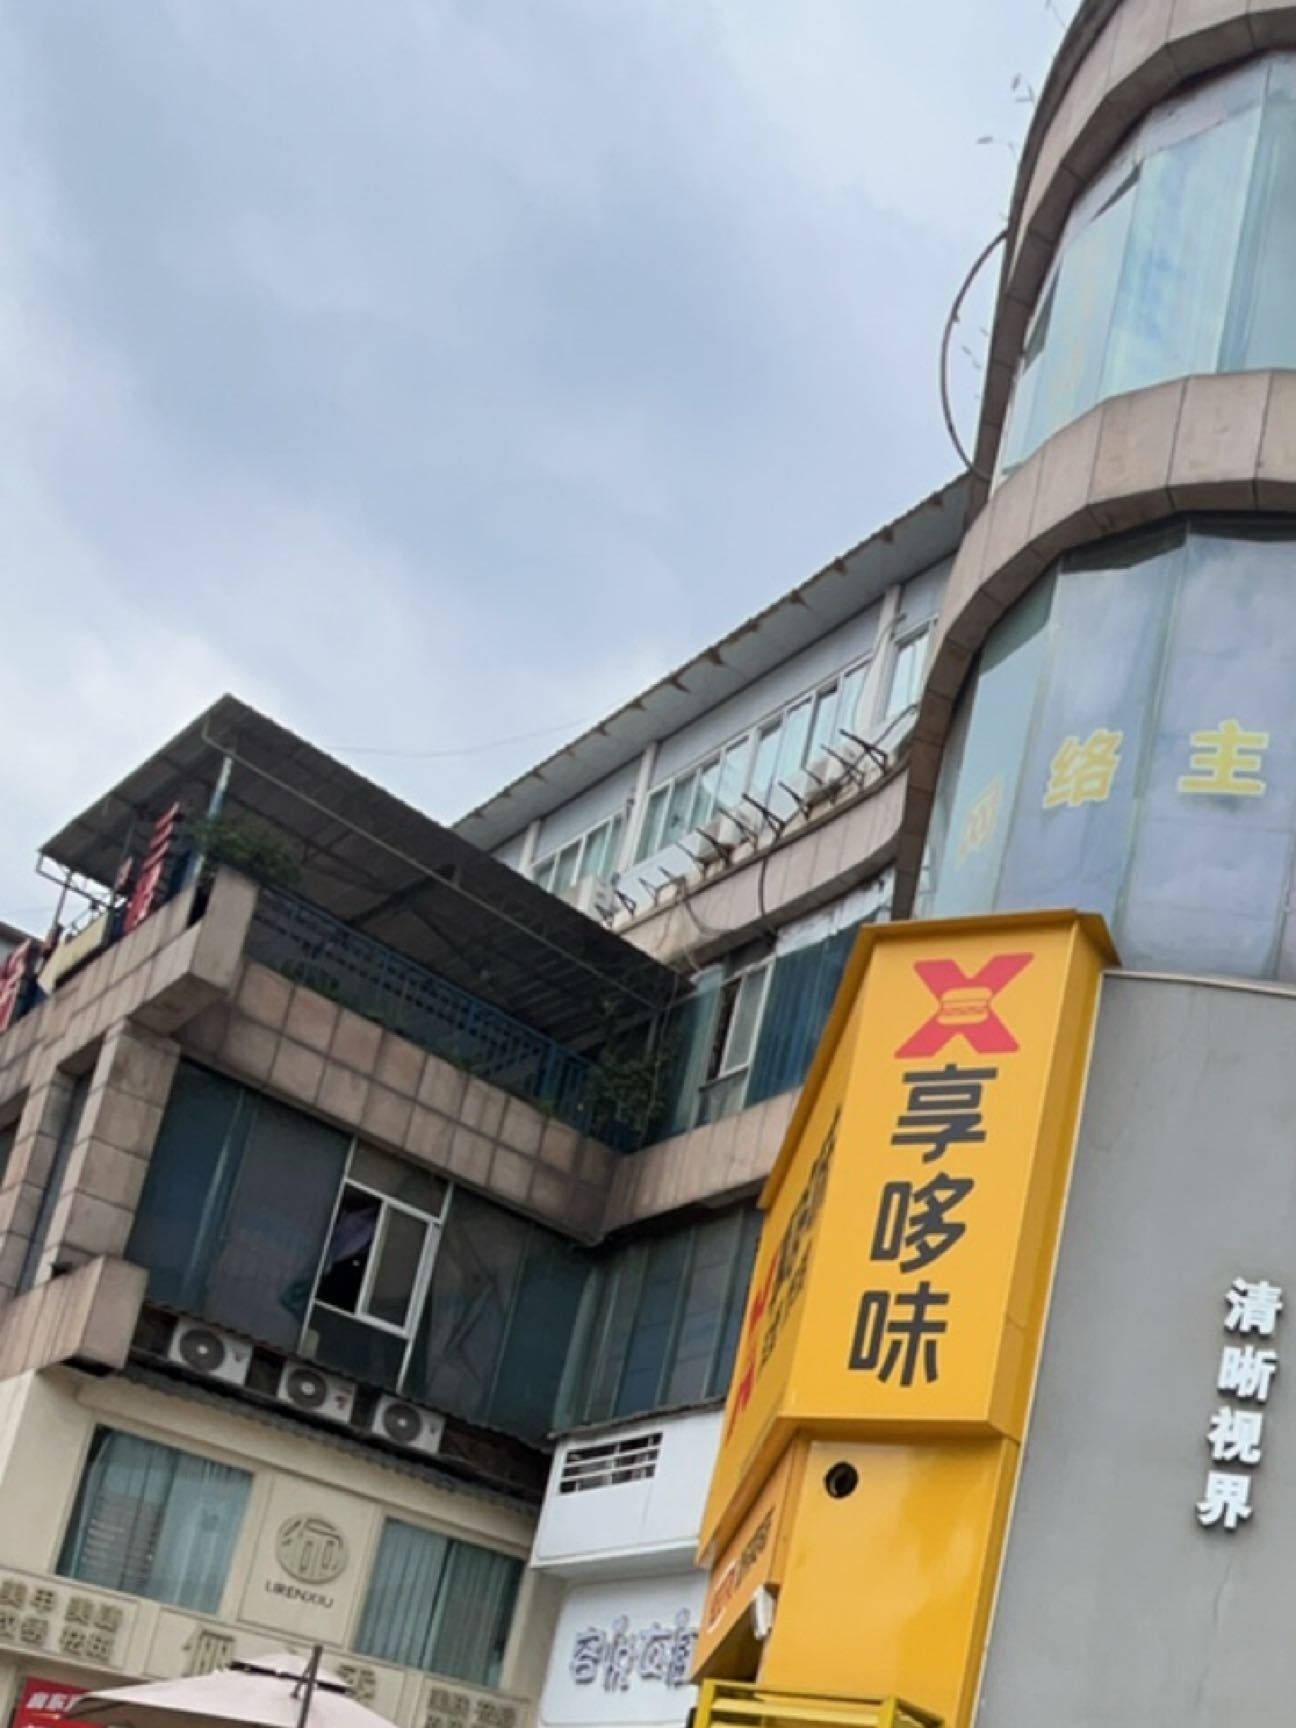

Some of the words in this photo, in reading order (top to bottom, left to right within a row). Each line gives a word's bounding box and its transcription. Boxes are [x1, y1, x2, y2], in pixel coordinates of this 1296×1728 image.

[848, 1063, 999, 1388] 享哆味
[1196, 1276, 1284, 1533] 清晰视界
